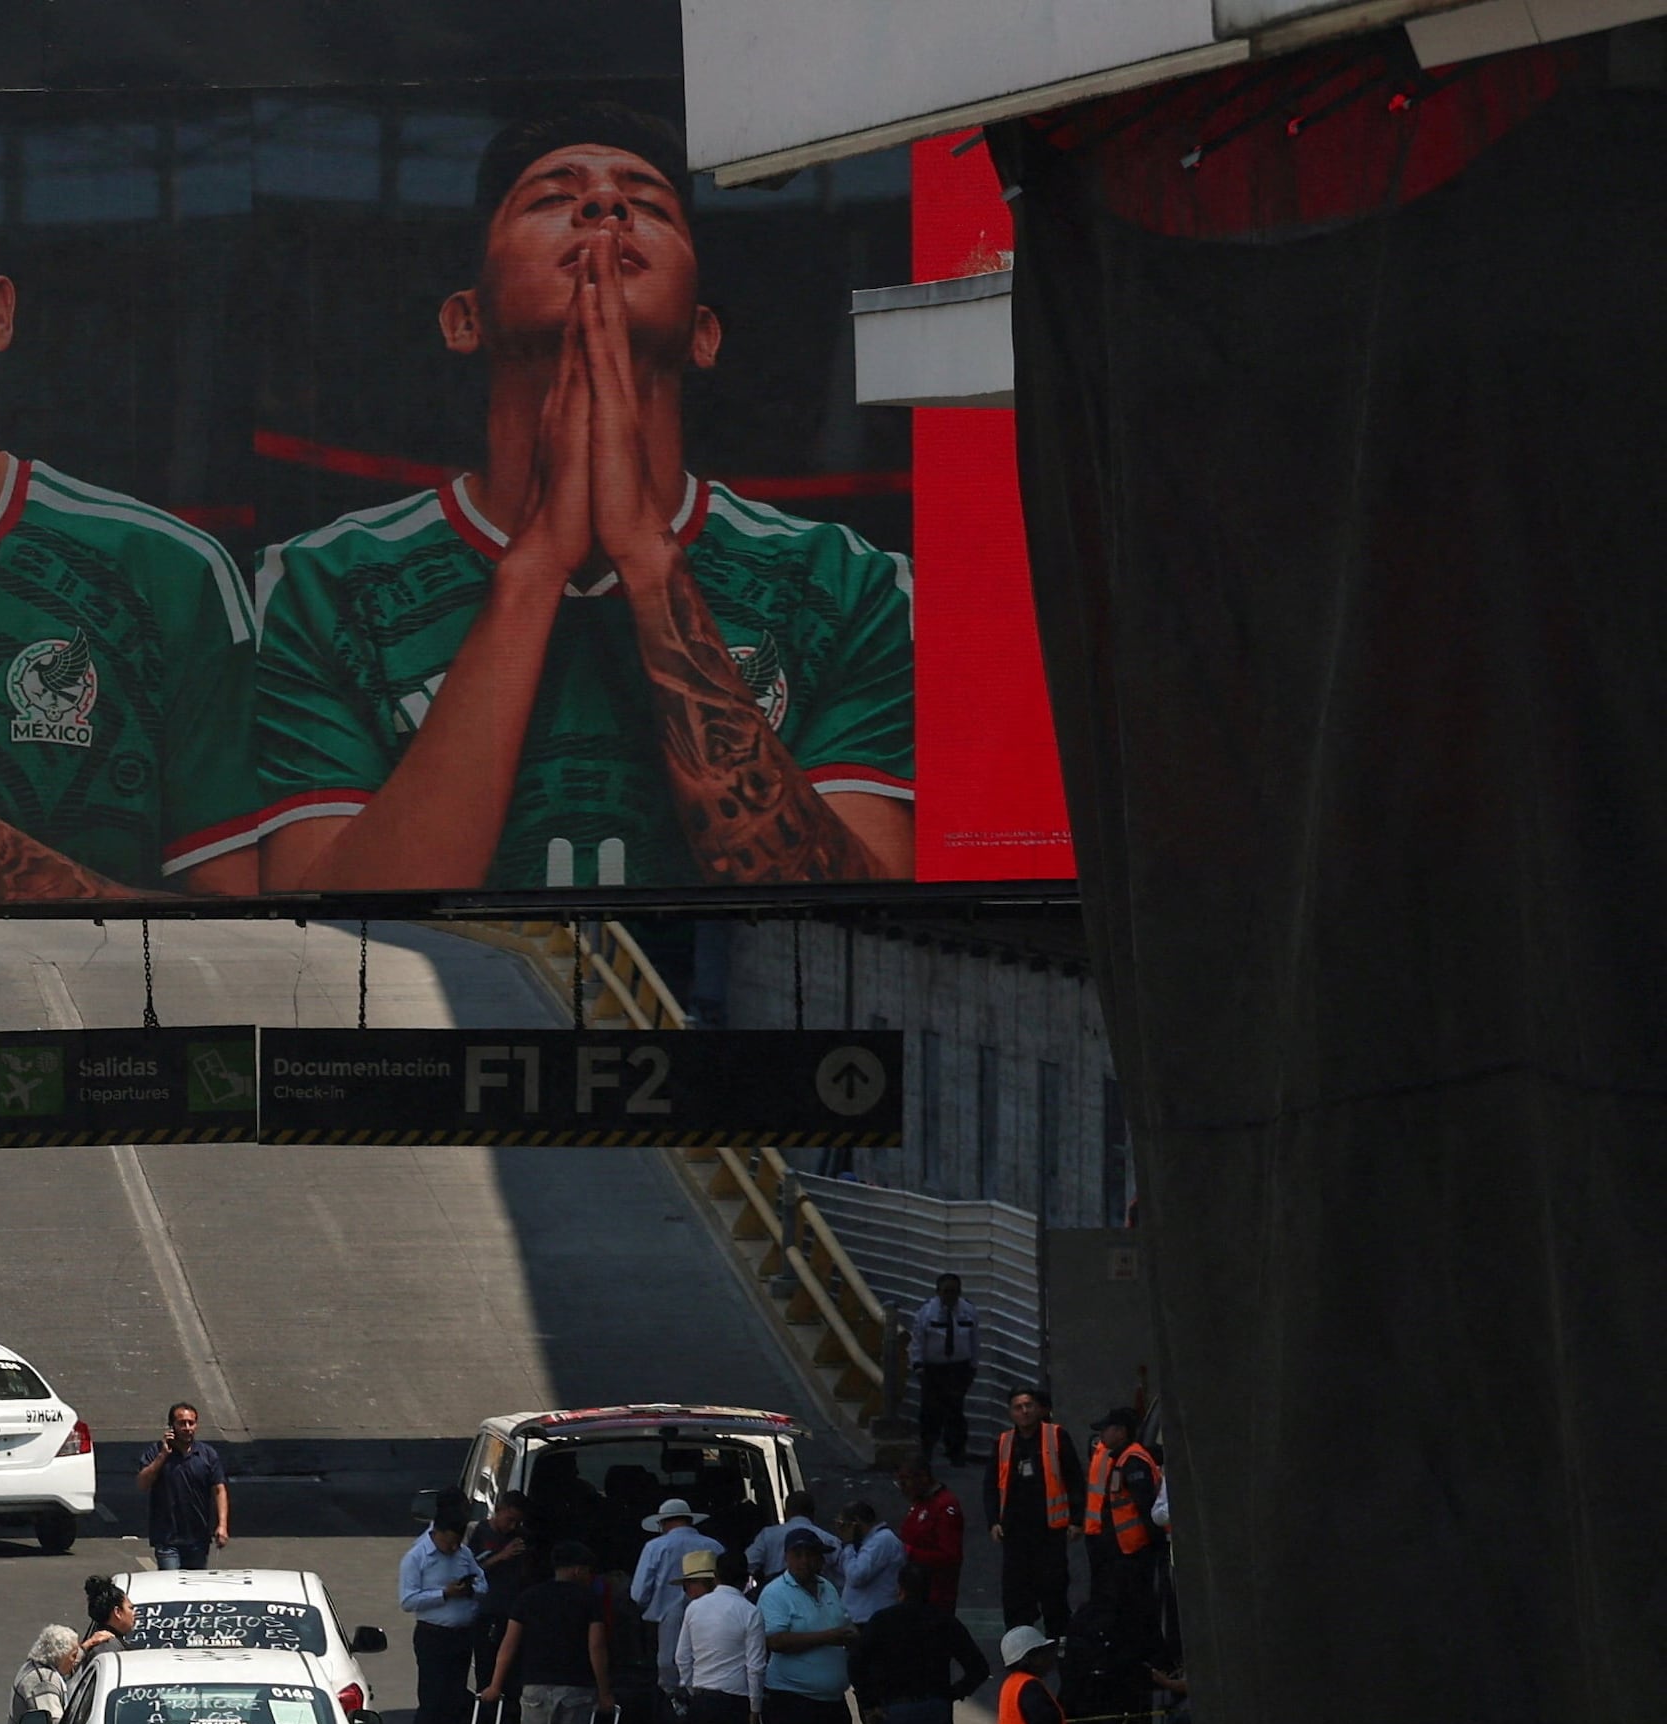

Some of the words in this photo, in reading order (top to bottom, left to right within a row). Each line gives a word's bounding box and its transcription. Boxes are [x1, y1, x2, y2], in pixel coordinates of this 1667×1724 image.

[12, 721, 92, 745] MÉXICO
[78, 1056, 158, 1078] Salidas
[274, 1057, 451, 1078] Documentación
[465, 1046, 541, 1113] F1
[577, 1046, 673, 1113] F2
[78, 1086, 170, 1105] Departures
[273, 1084, 347, 1100] Check-in
[182, 1602, 238, 1617] LOS
[266, 1603, 308, 1618] 0717
[270, 1687, 315, 1701] 0148
